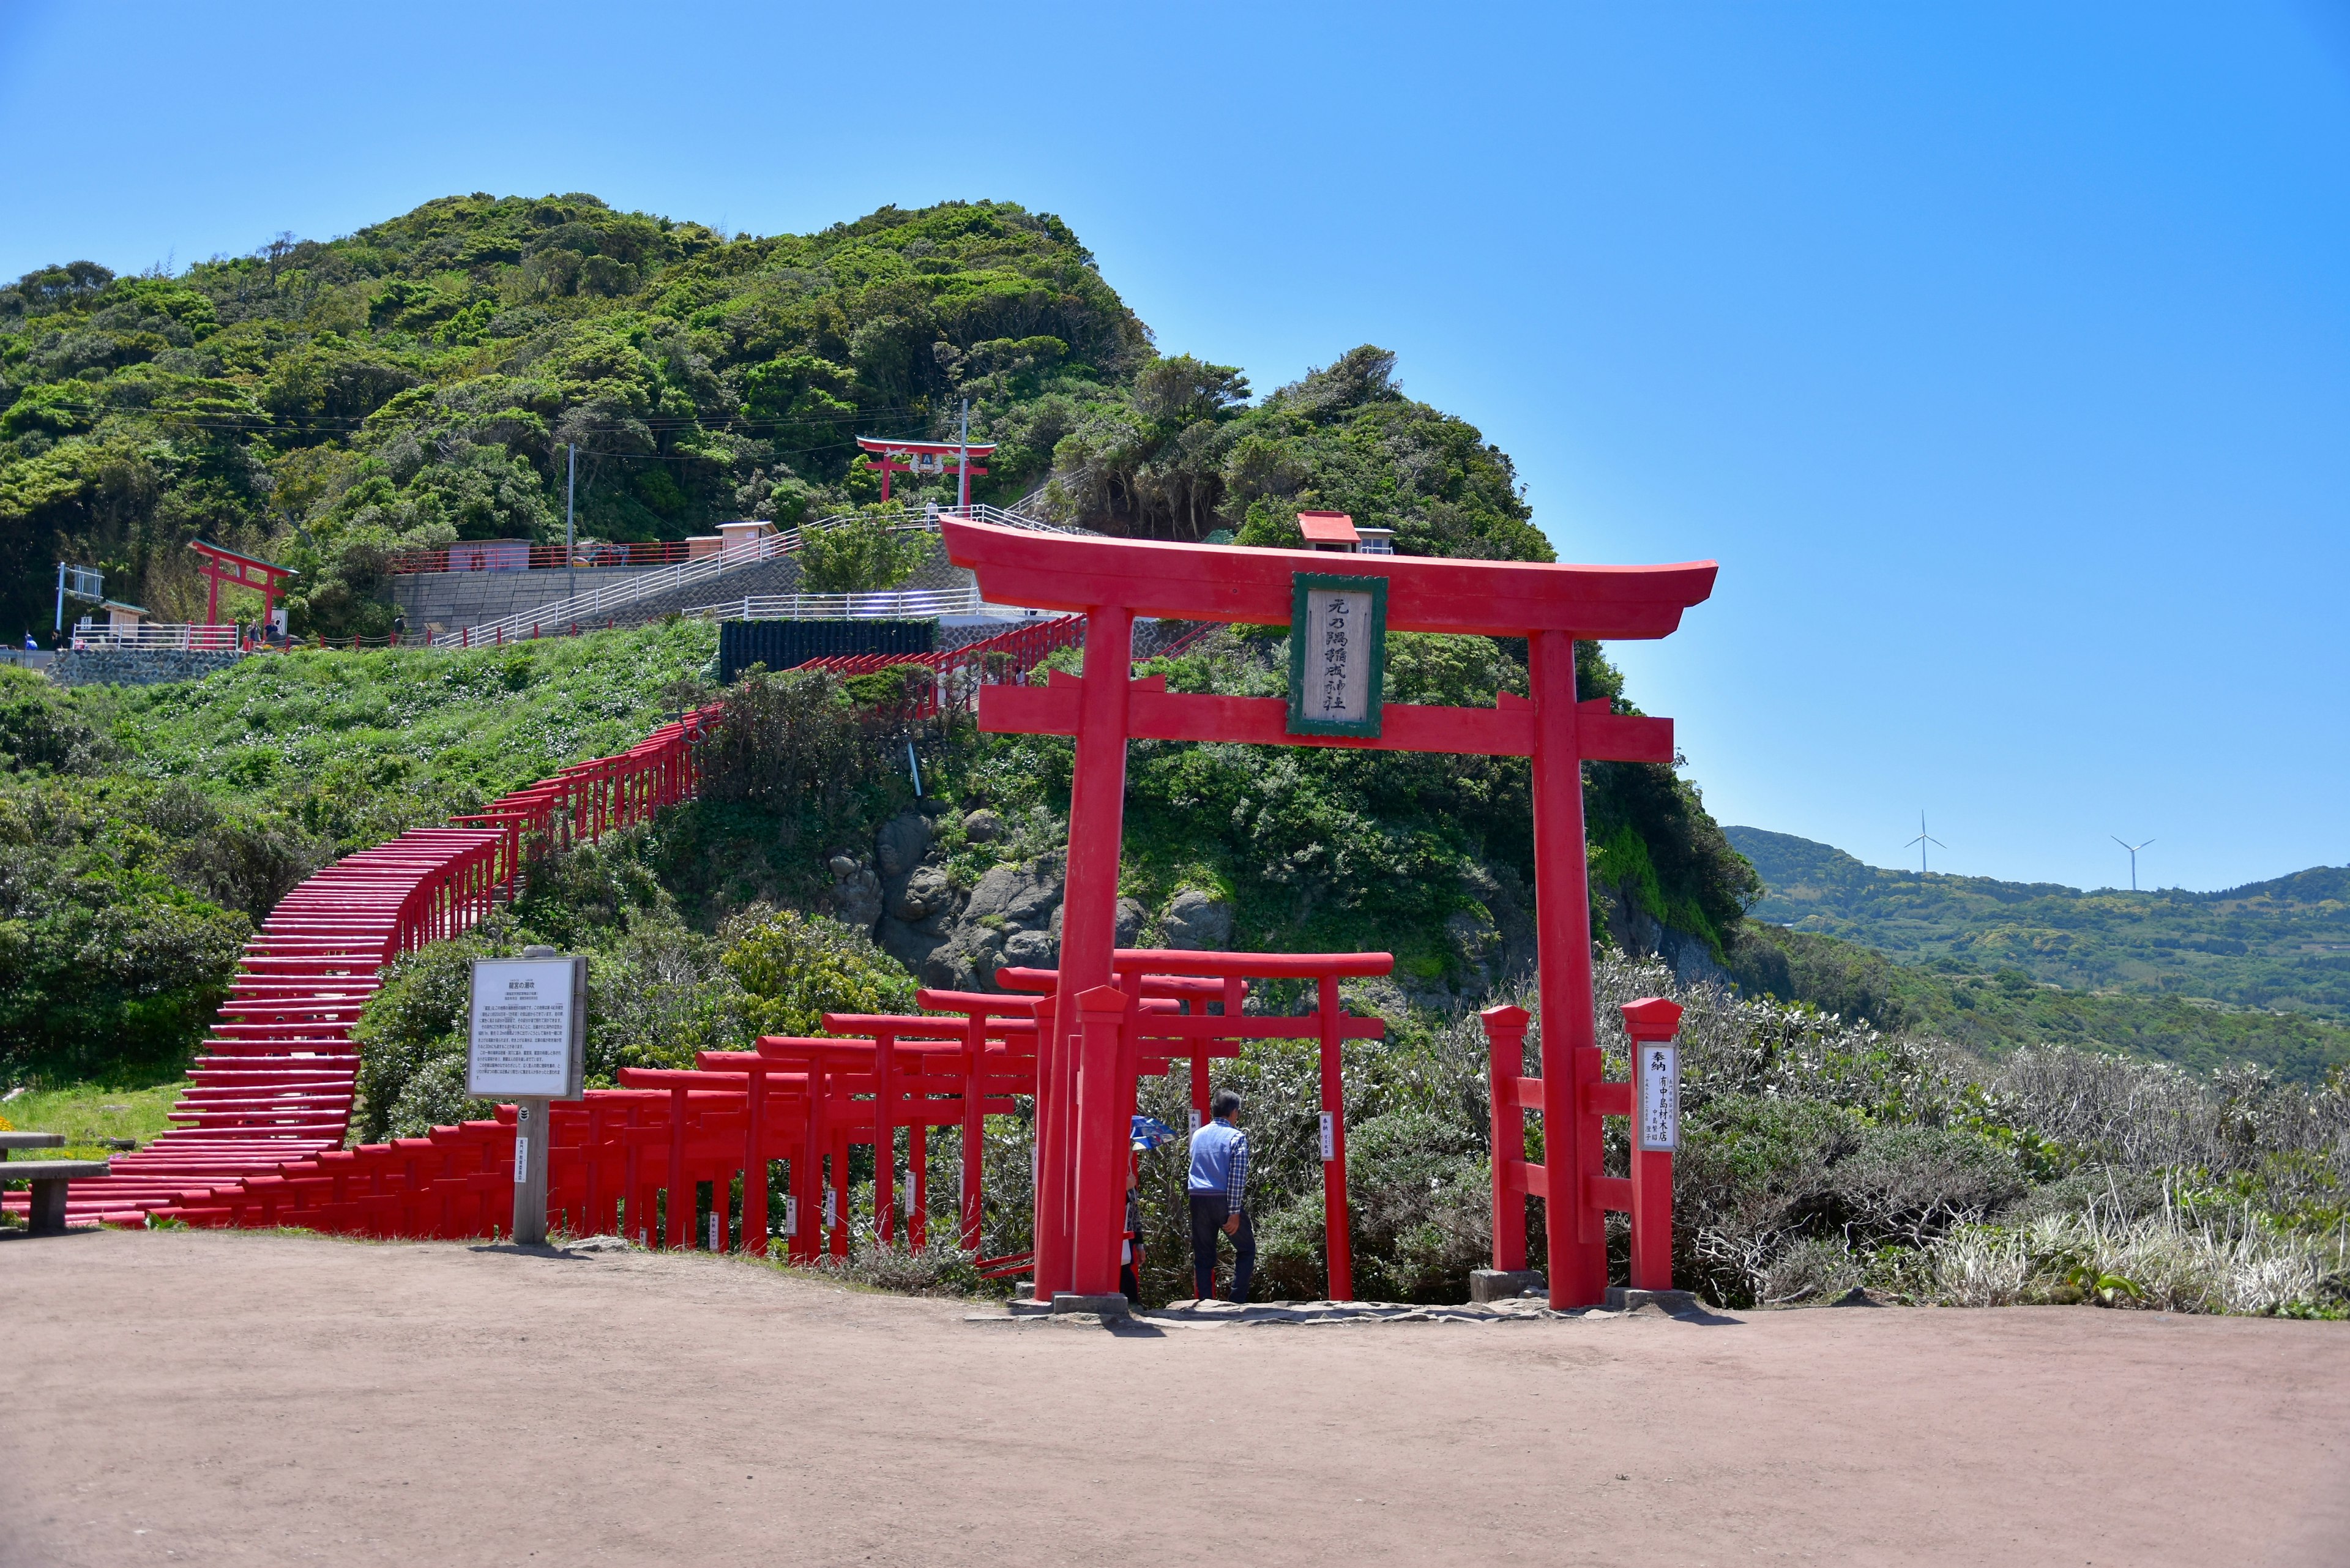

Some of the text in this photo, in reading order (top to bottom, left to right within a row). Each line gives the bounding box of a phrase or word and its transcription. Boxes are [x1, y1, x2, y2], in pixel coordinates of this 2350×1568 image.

[1324, 599, 1349, 711] 元乃隅稲成神社
[1651, 1051, 1666, 1071] 奉納
[1322, 1118, 1328, 1131] 奉納
